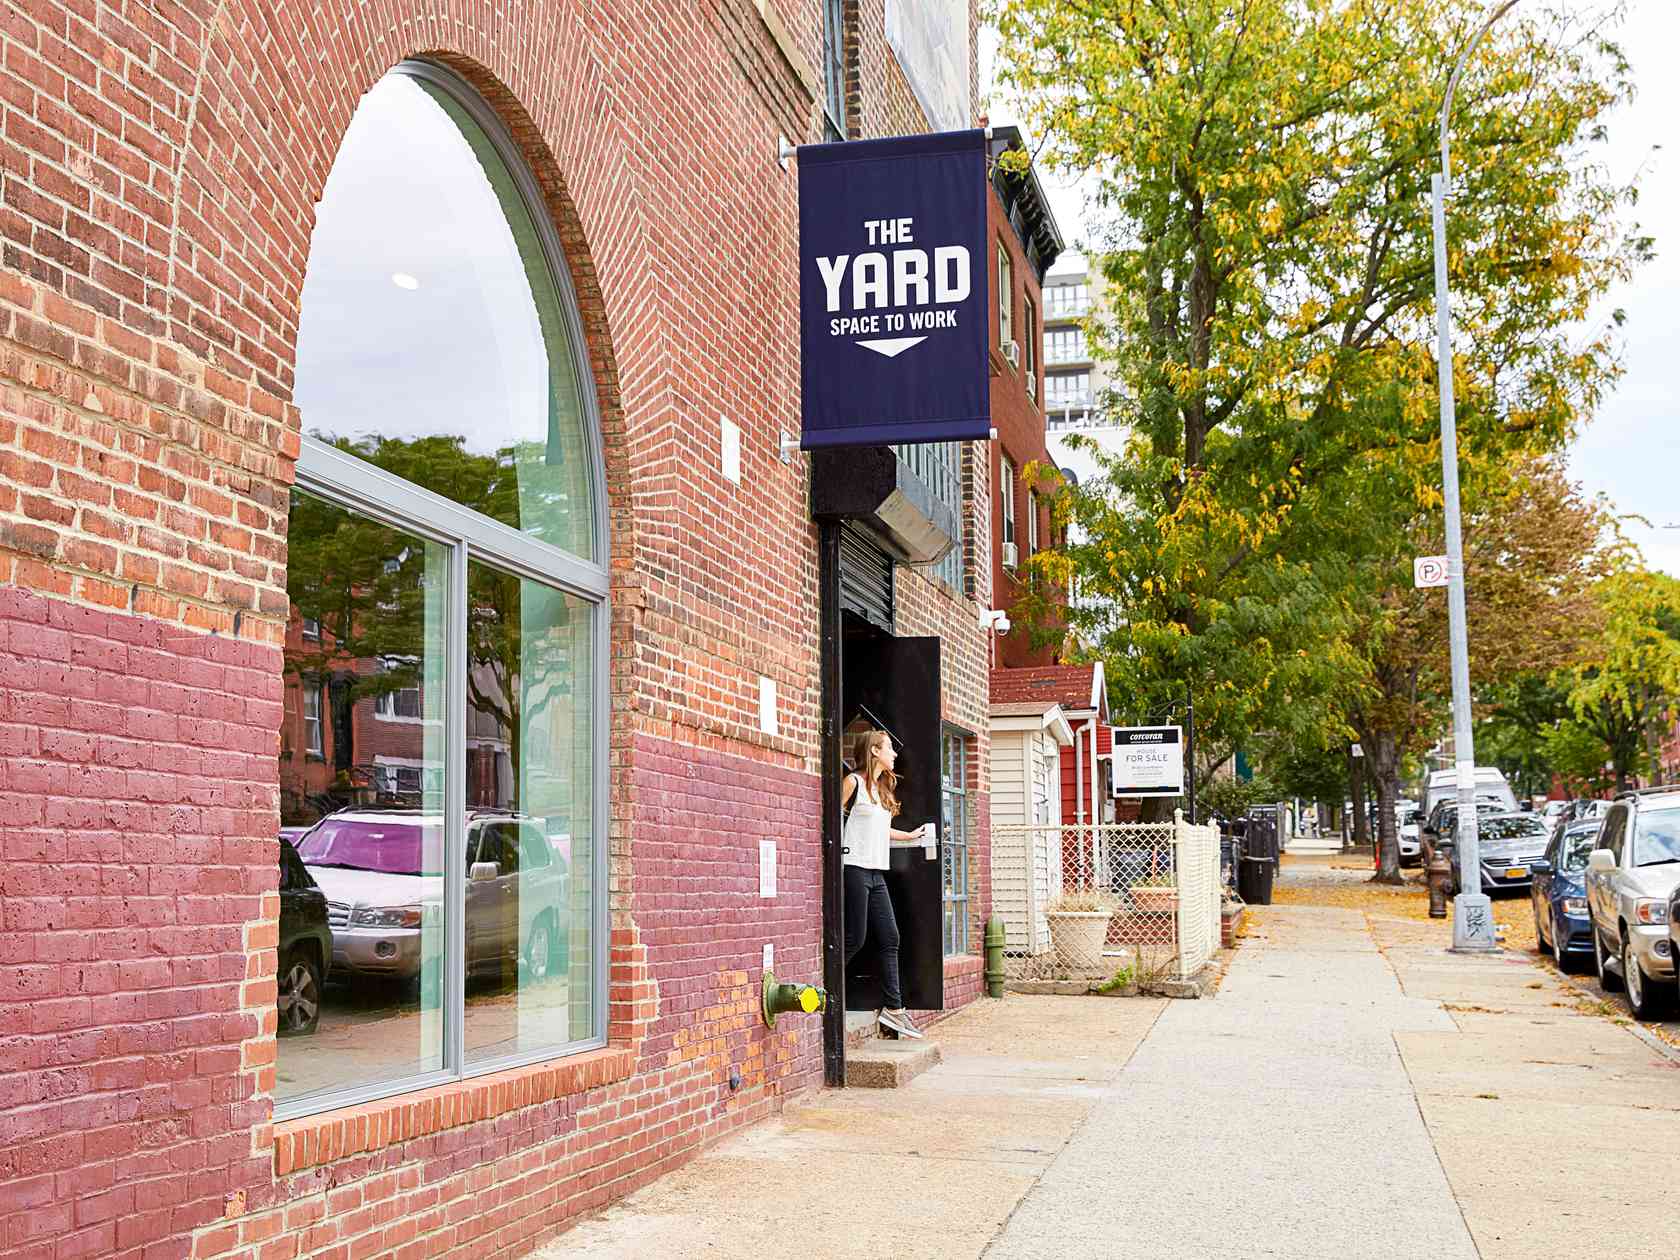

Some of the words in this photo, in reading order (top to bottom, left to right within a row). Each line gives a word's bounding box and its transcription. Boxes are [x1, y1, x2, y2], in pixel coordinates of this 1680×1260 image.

[864, 218, 914, 246] THE
[815, 245, 971, 313] YARD
[830, 315, 880, 336] SPACE
[885, 312, 905, 332] TO
[908, 310, 957, 329] WORK
[1126, 754, 1143, 762] FOR
[1145, 753, 1168, 762] SALE
